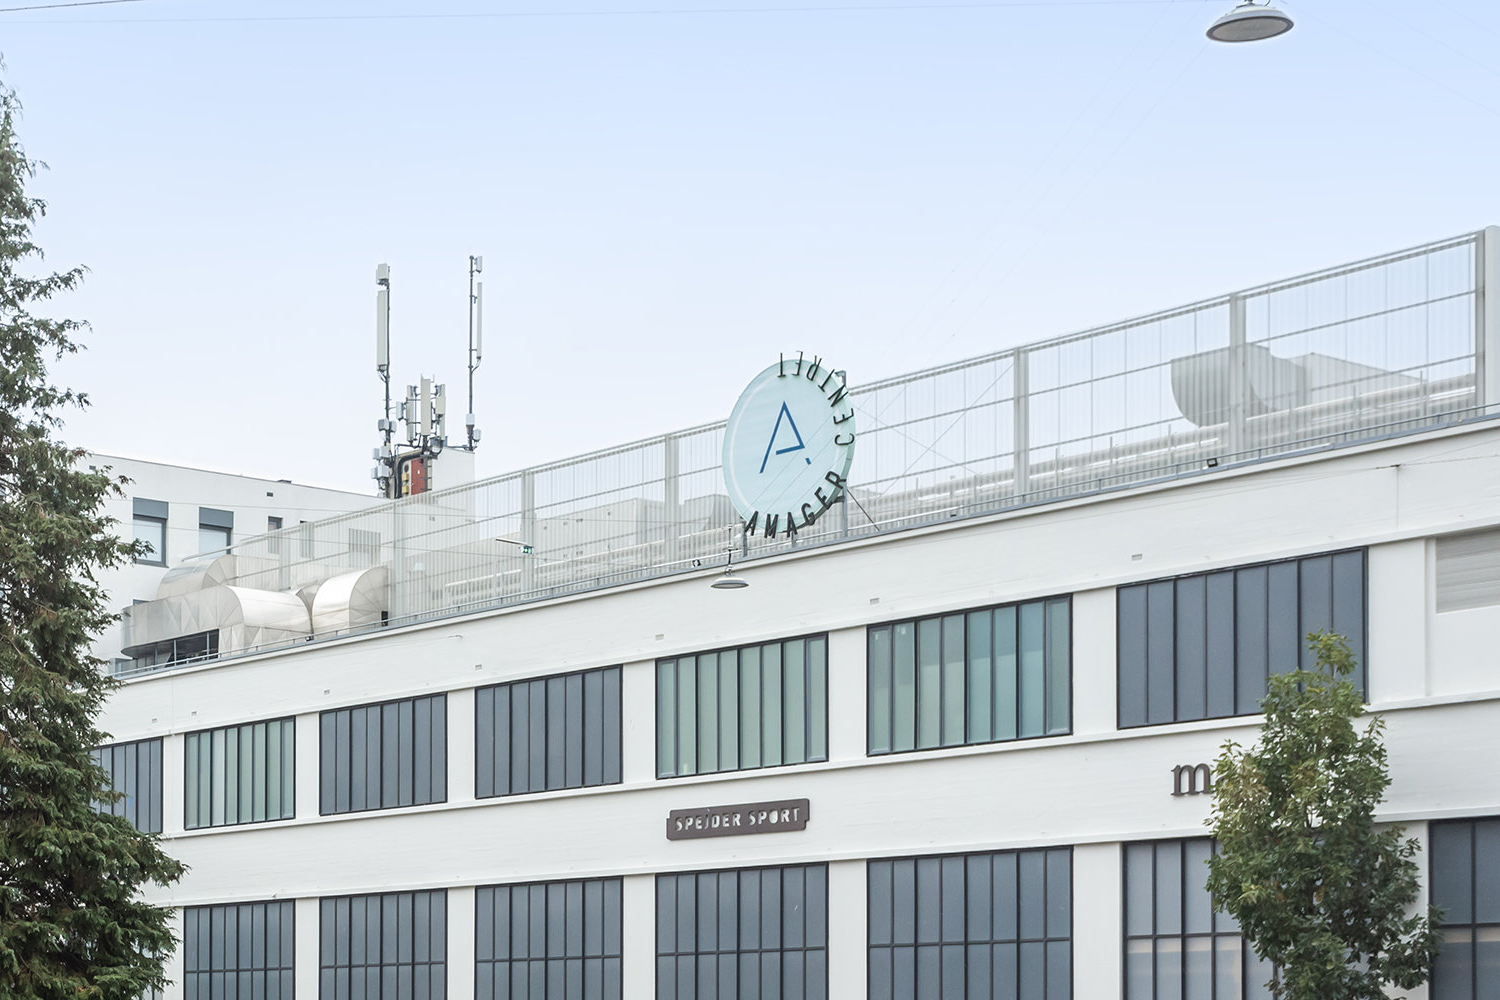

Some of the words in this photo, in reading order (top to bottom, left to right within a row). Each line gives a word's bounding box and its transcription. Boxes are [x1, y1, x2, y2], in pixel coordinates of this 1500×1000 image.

[777, 350, 855, 446] CENTRET
[744, 470, 847, 539] AMAGER
[675, 810, 741, 832] SPEJDER
[748, 807, 800, 826] SPORT
